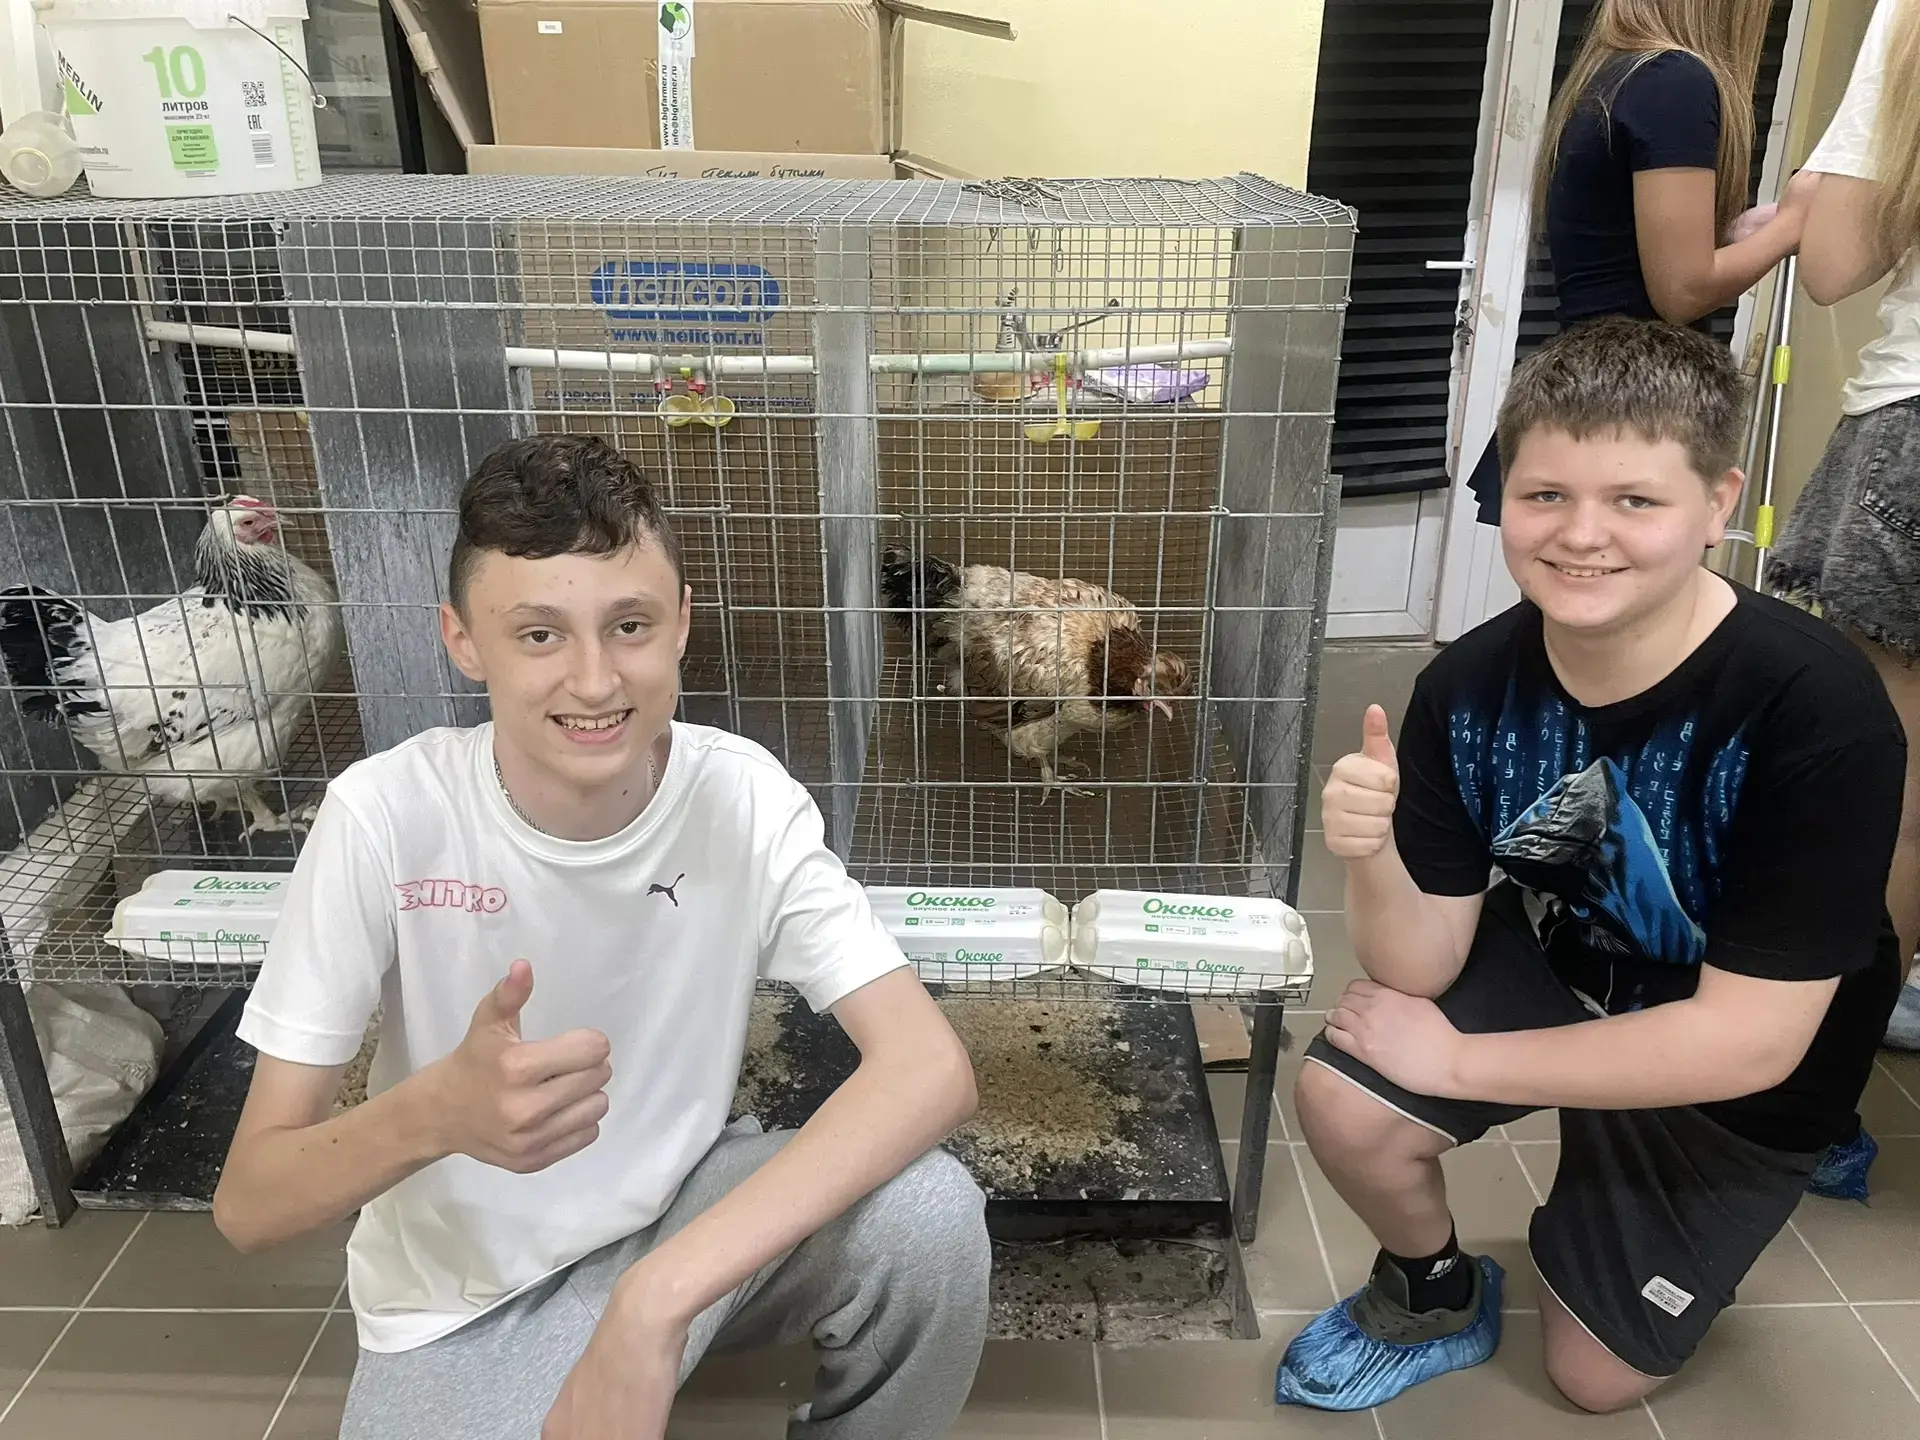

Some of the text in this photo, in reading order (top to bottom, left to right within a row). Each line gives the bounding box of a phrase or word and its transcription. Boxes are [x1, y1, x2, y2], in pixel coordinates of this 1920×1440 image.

[58, 49, 103, 112] MERLIN
[142, 45, 206, 98] 10
[162, 101, 209, 113] литров
[661, 65, 669, 146] www.bigfarmer.ru
[671, 66, 679, 146] info@bigfarmer.ru
[612, 261, 759, 318] helicon
[613, 329, 763, 345] www.helicon.ru
[193, 876, 281, 890] Окское
[394, 879, 507, 913] NITRO
[906, 892, 997, 907] Окское
[1142, 898, 1236, 918] Окское
[215, 929, 261, 942] Окское
[955, 949, 1003, 961] Окское
[1195, 959, 1245, 973] Окское
